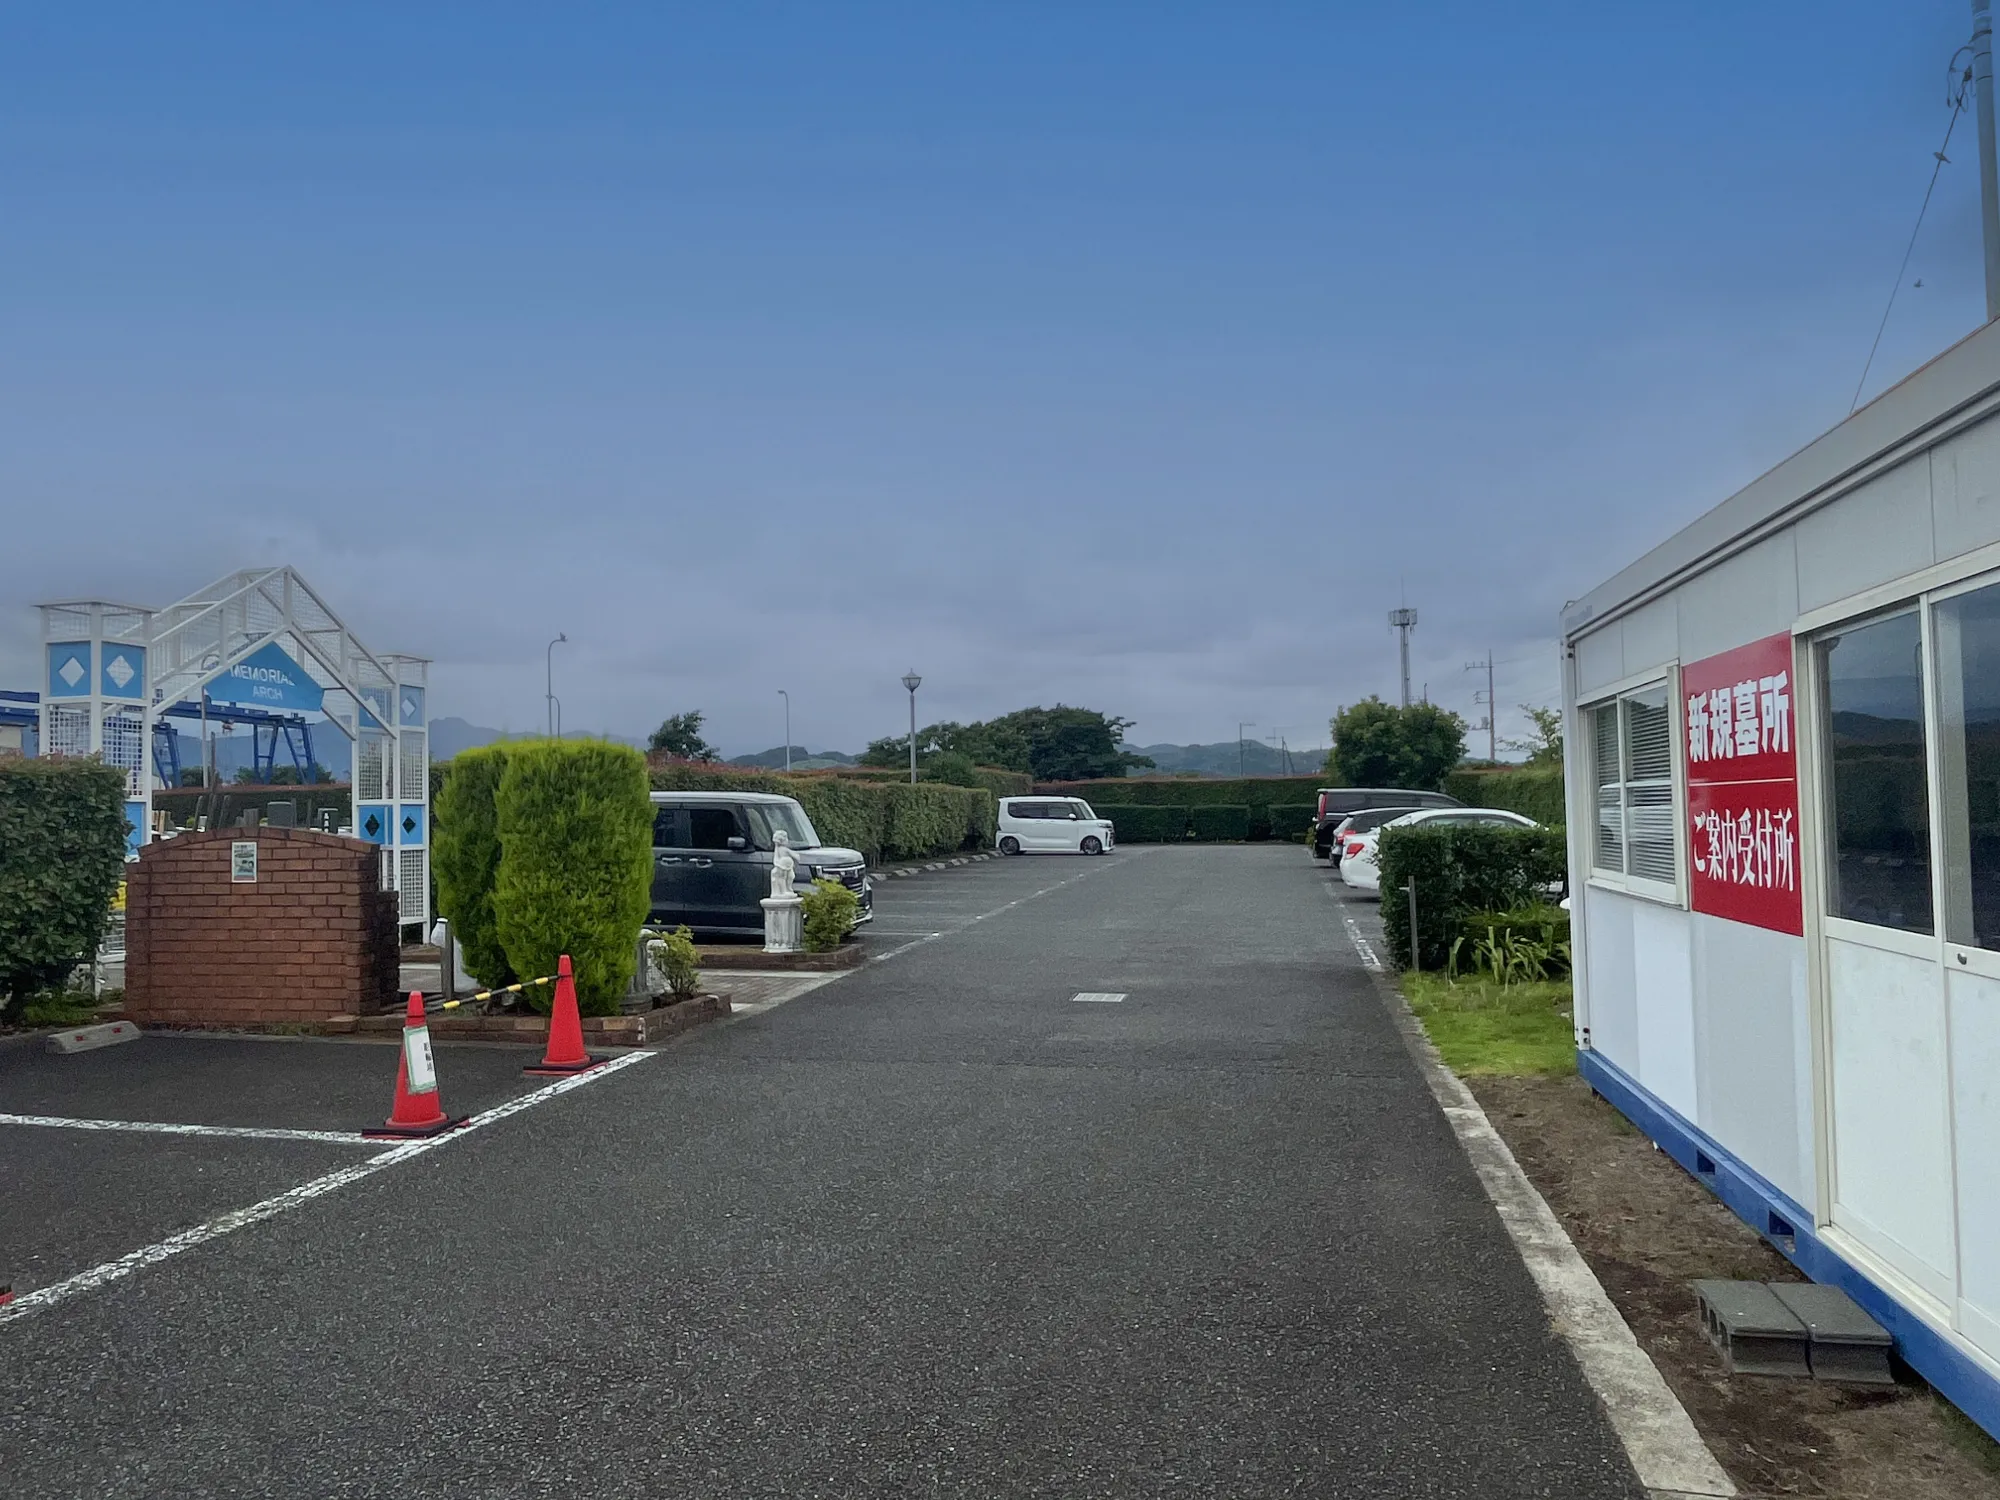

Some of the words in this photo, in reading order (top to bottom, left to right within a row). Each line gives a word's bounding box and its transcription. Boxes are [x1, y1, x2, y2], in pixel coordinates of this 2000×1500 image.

[252, 685, 283, 700] ARCH
[1688, 670, 1789, 763] 新規墓所
[1693, 807, 1794, 892] ご案内受付所
